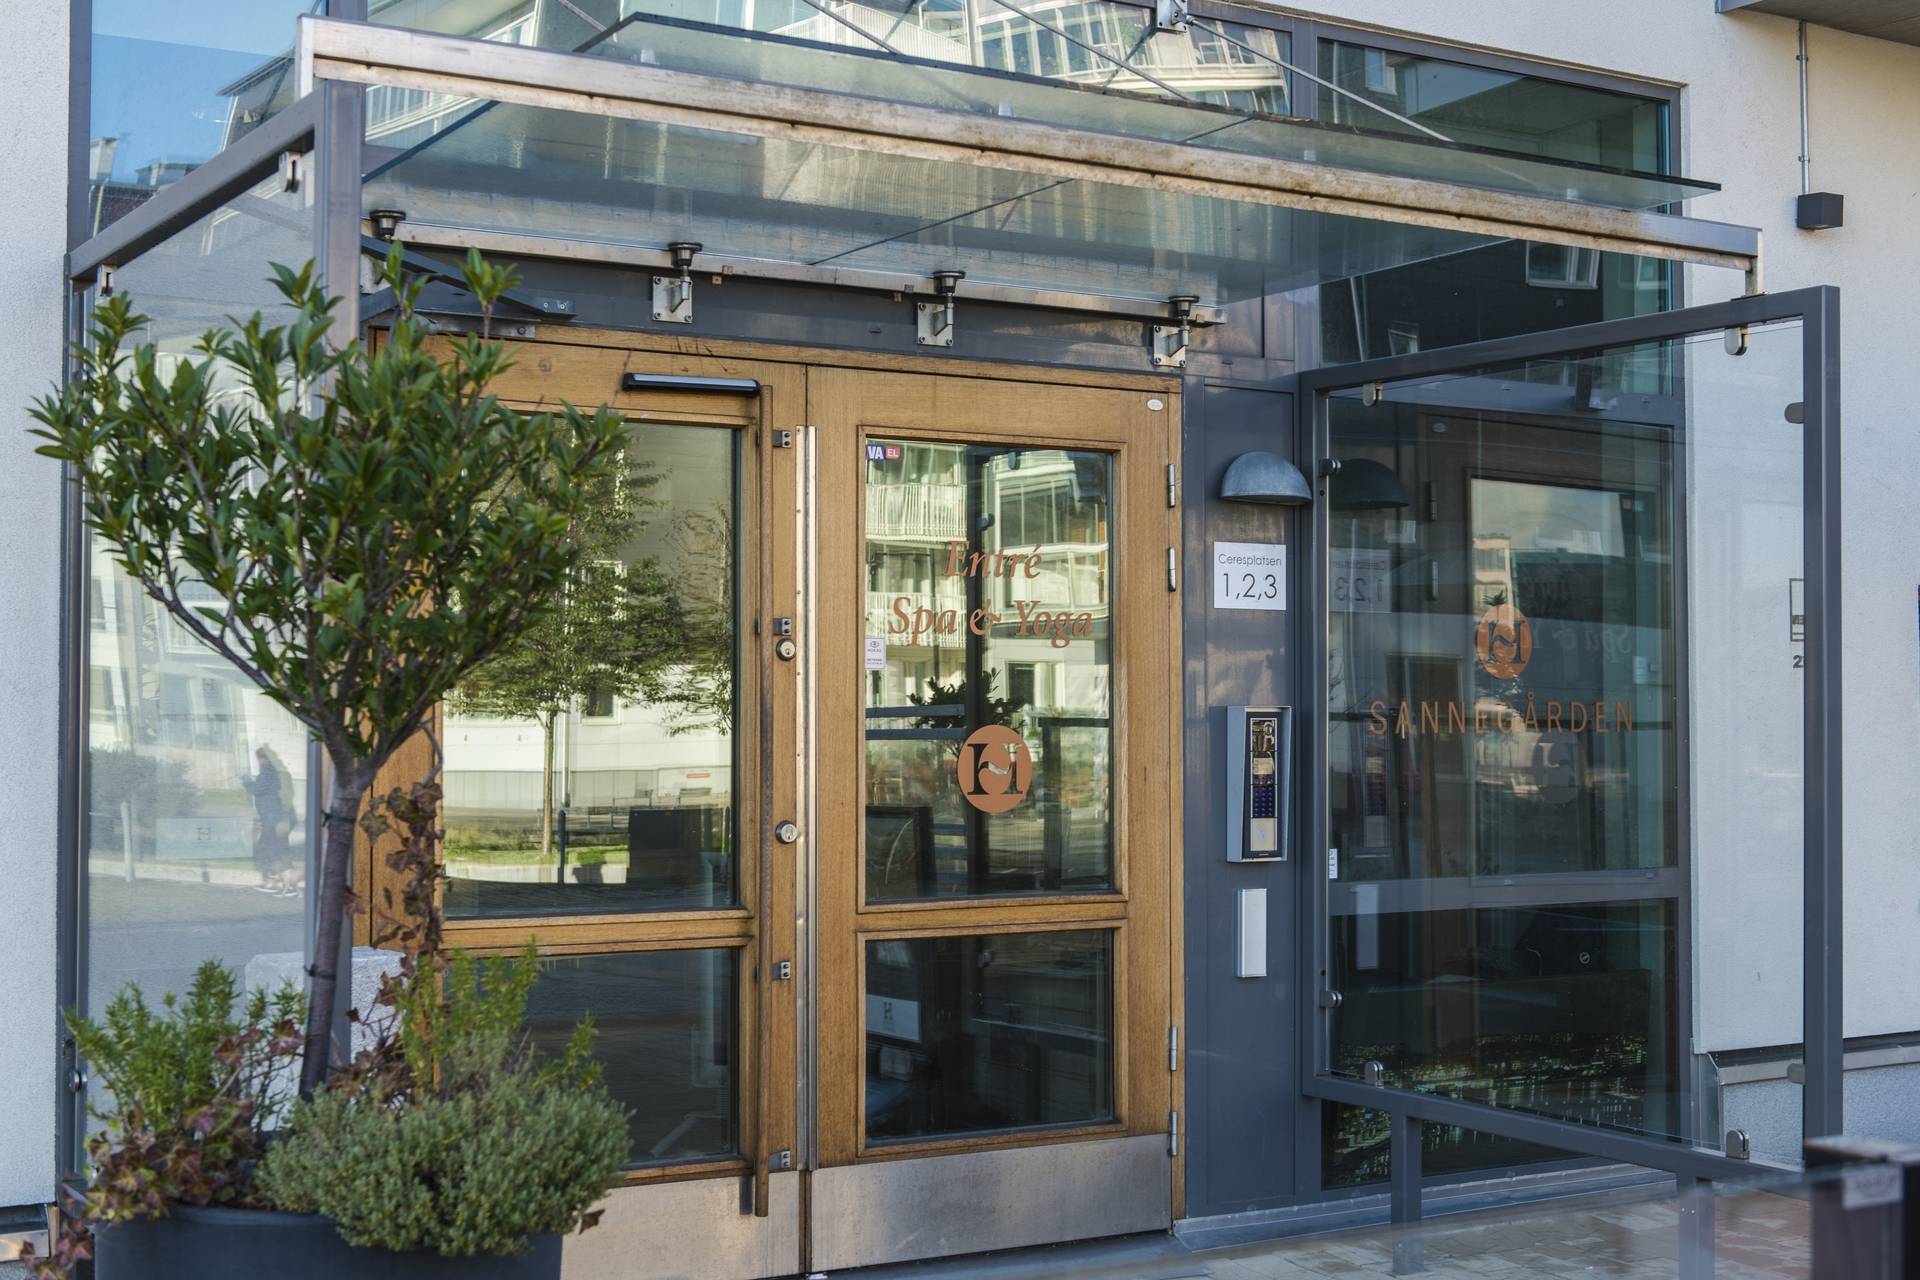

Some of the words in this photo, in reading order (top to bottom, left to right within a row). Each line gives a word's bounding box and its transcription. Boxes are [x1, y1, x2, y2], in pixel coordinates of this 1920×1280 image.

[887, 448, 899, 457] EL
[944, 541, 1042, 579] Entré
[1218, 553, 1282, 567] Ceresplatsen
[1223, 573, 1277, 600] 1,2,3
[889, 597, 957, 646] Spa
[970, 599, 1001, 636] &
[1014, 600, 1093, 648] Yoga
[1369, 690, 1634, 735] SANNEGÅRDEN
